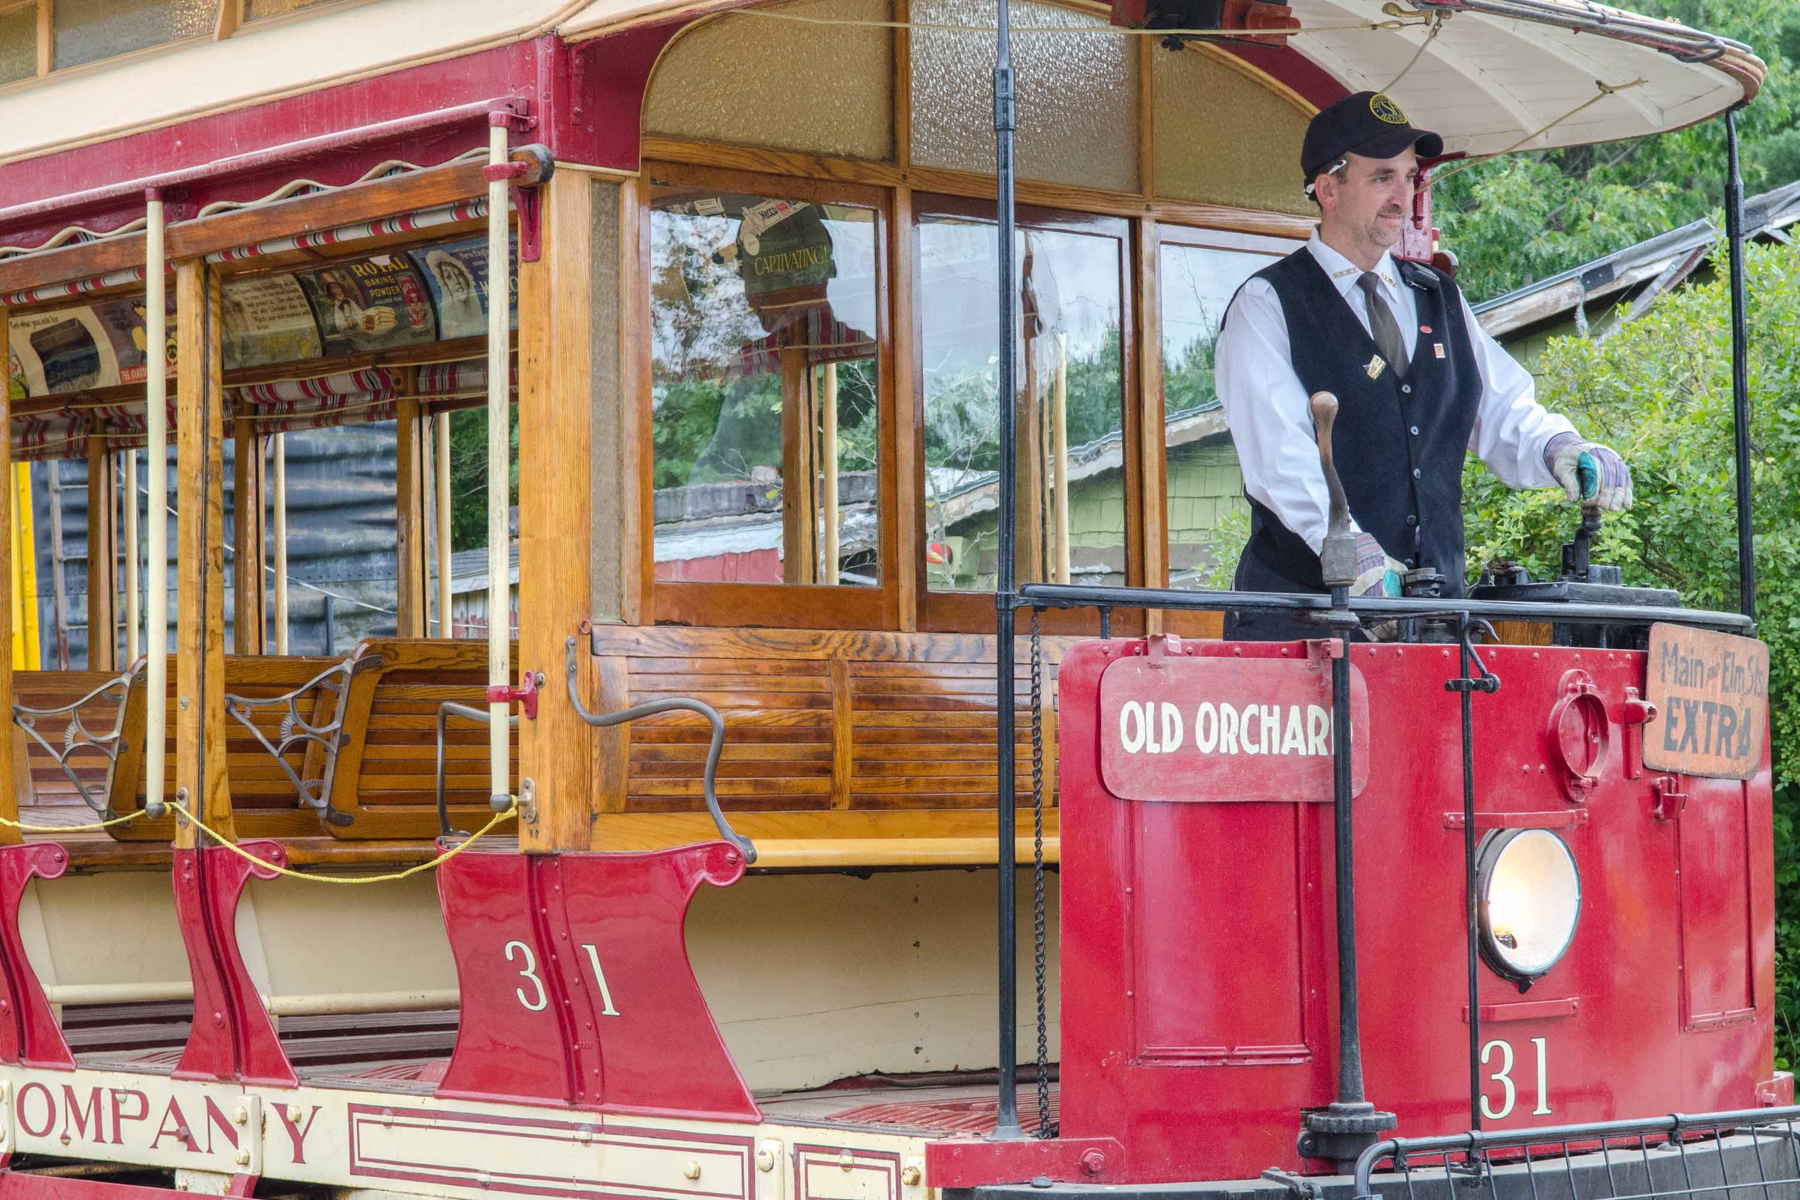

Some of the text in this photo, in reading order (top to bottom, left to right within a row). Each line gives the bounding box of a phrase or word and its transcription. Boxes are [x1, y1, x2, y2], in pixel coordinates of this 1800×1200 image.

[1661, 640, 1705, 690] Main
[1721, 650, 1745, 693] Elm
[1120, 700, 1353, 756] OLD ORCHAR
[1663, 697, 1752, 760] EXTRA
[1480, 1037, 1552, 1119] 31
